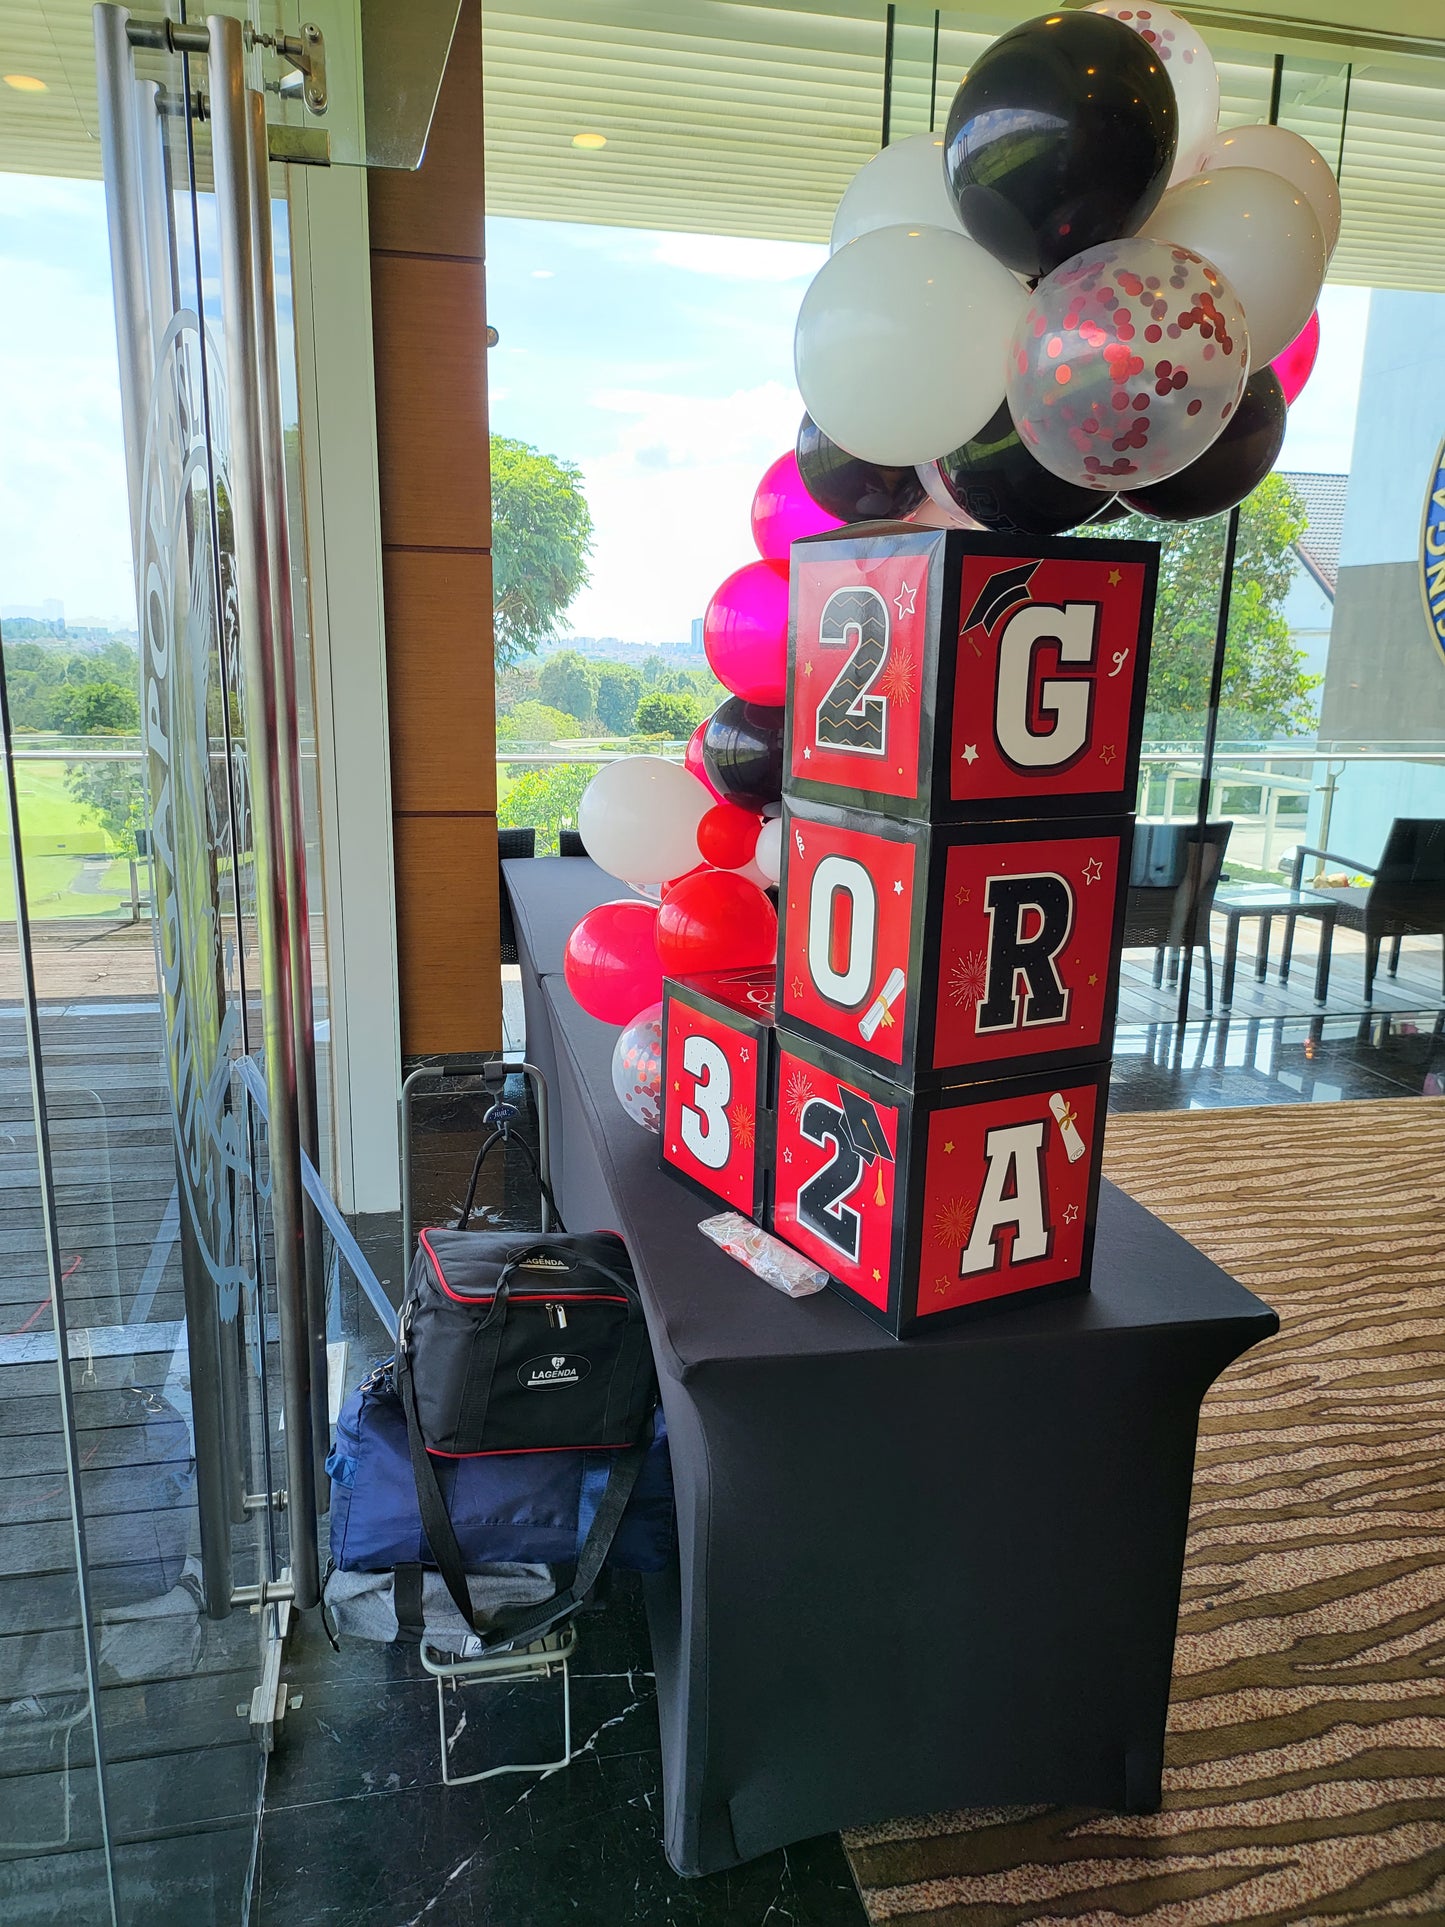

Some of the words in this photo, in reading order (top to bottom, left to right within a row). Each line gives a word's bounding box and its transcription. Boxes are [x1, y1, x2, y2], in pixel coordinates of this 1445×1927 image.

[815, 585, 890, 755] 2
[994, 602, 1101, 770] G
[975, 872, 1074, 1034] R
[681, 1036, 732, 1169] 3
[796, 1097, 863, 1264] 2
[522, 1256, 565, 1266] AGENDA
[960, 1122, 1050, 1278] A
[532, 1368, 577, 1379] LAGENDA
